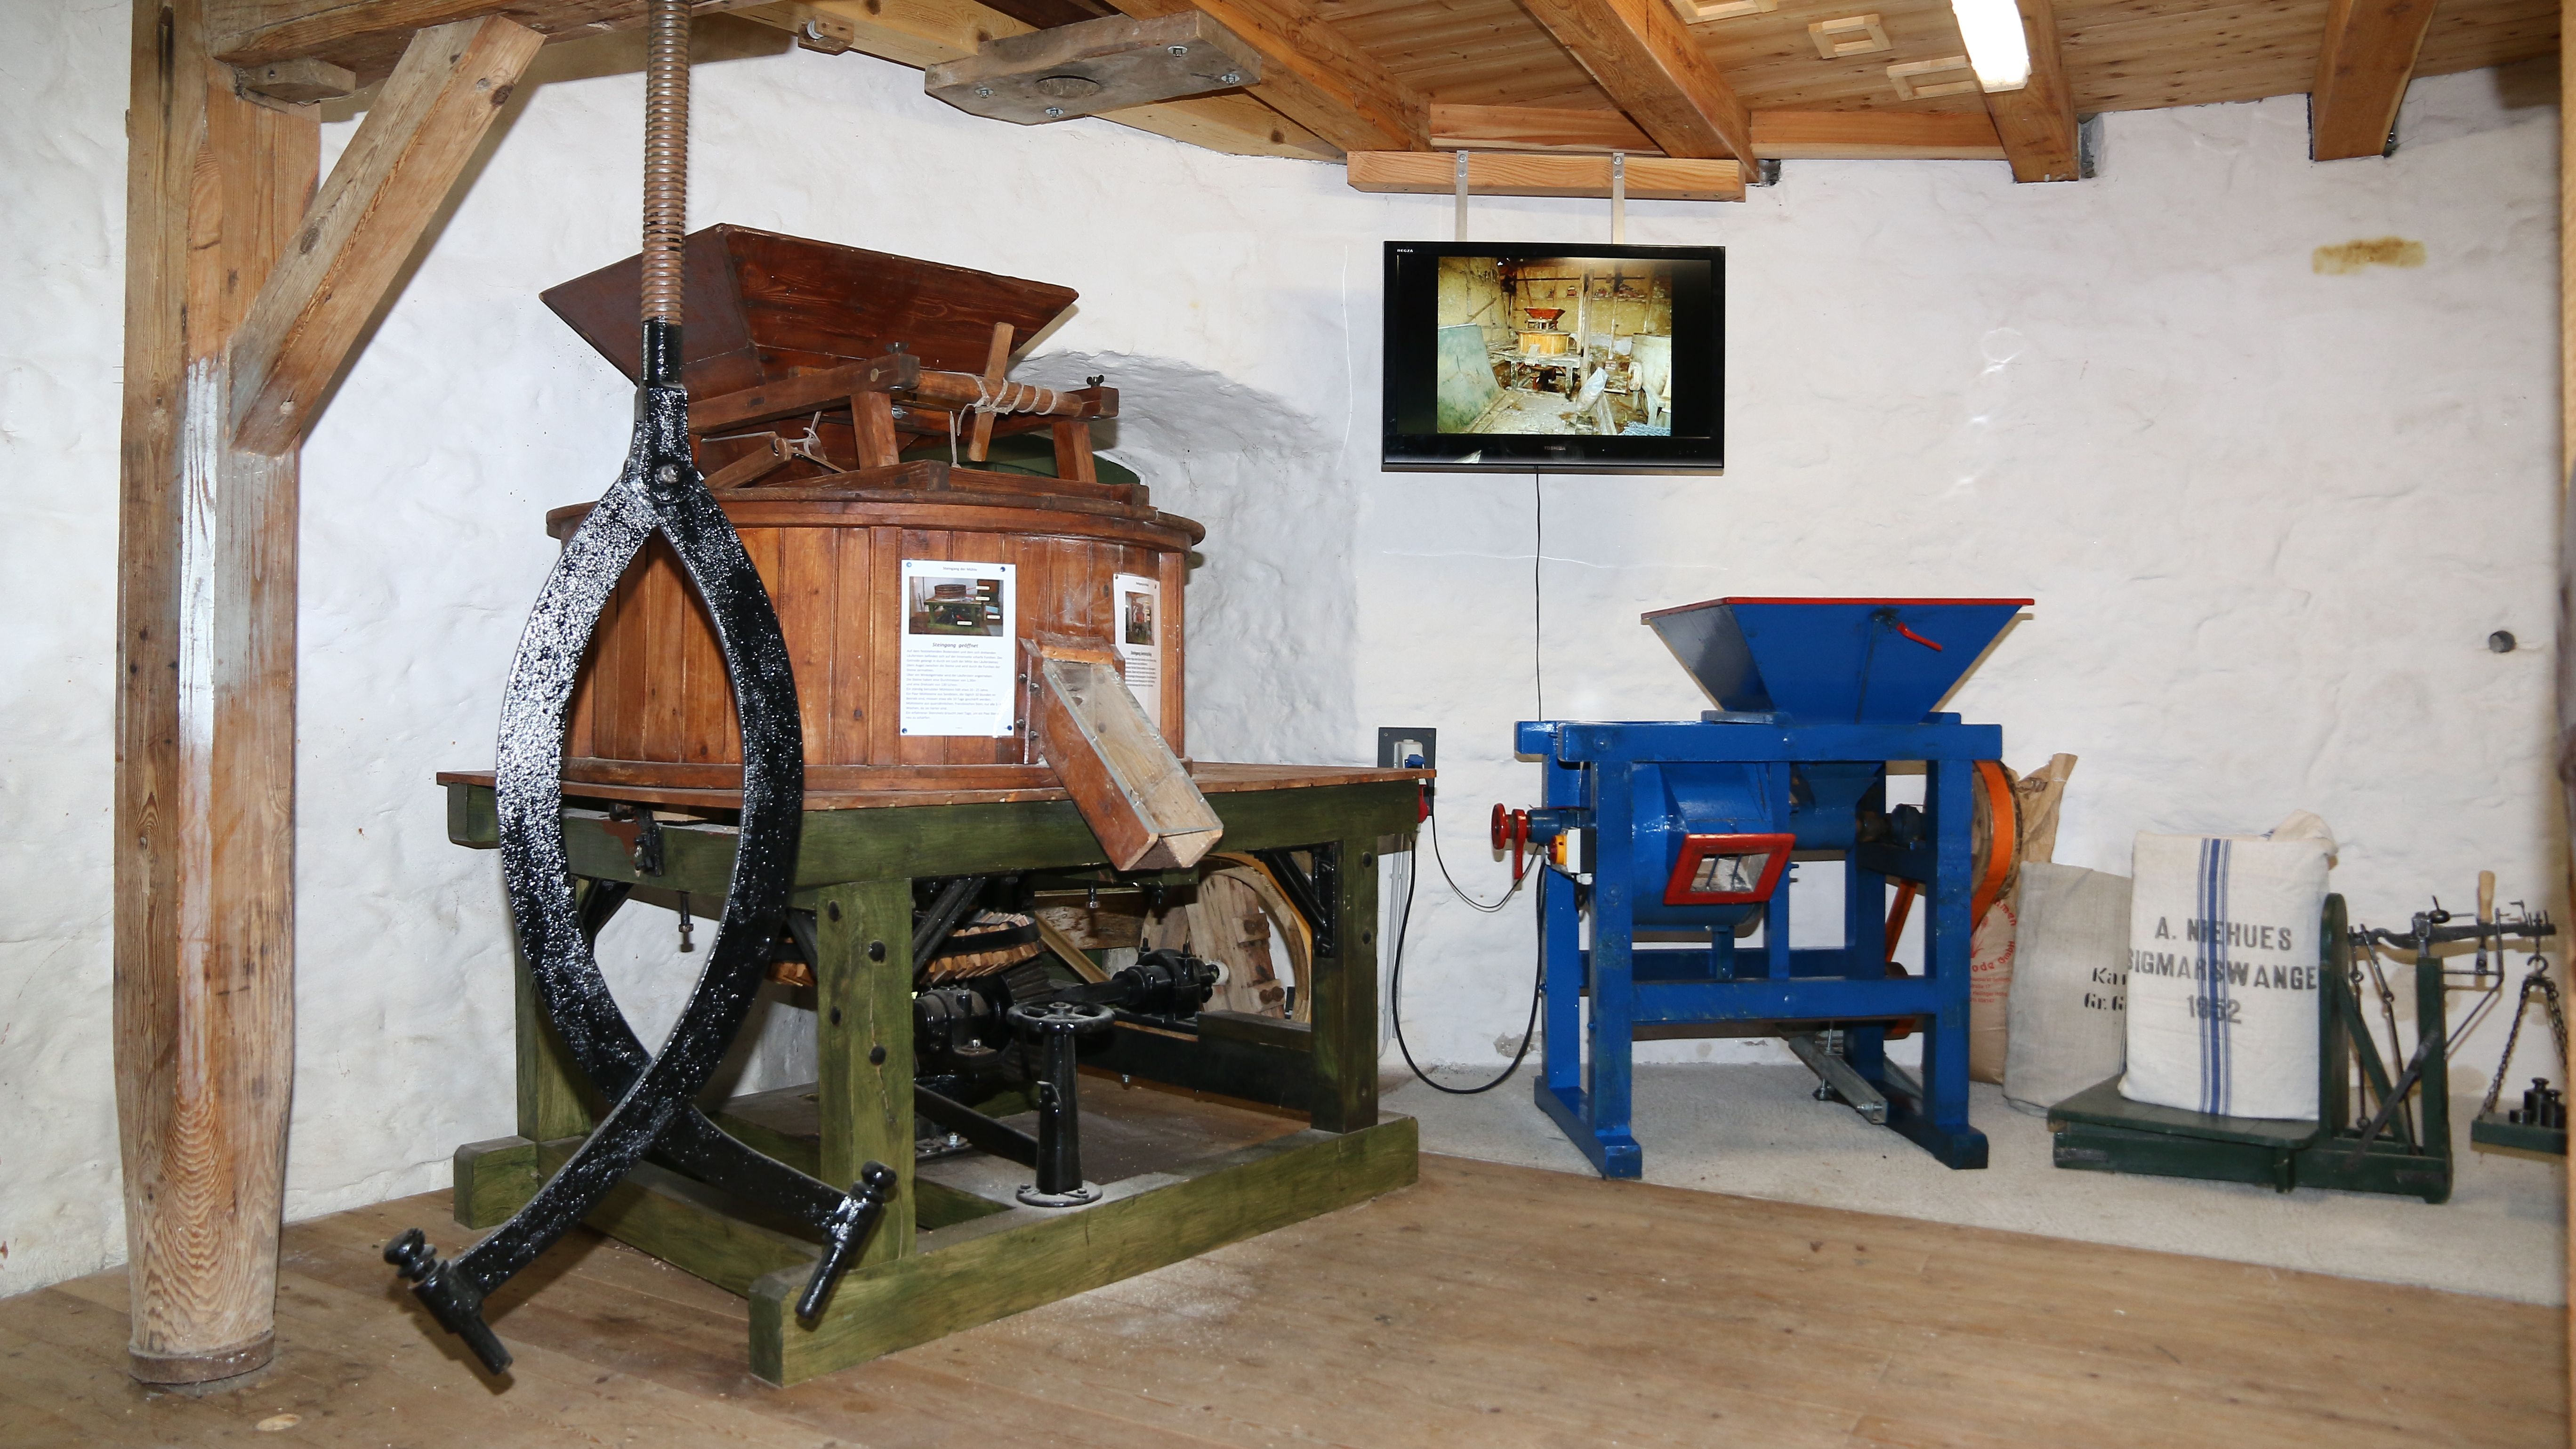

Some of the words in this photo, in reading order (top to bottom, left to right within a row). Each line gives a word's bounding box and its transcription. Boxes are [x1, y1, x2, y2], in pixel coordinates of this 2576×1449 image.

[2155, 916, 2176, 940] A.
[2187, 918, 2292, 951] NIEHUES
[1997, 940, 2015, 965] GmbH
[2084, 992, 2107, 1009] Gr.
